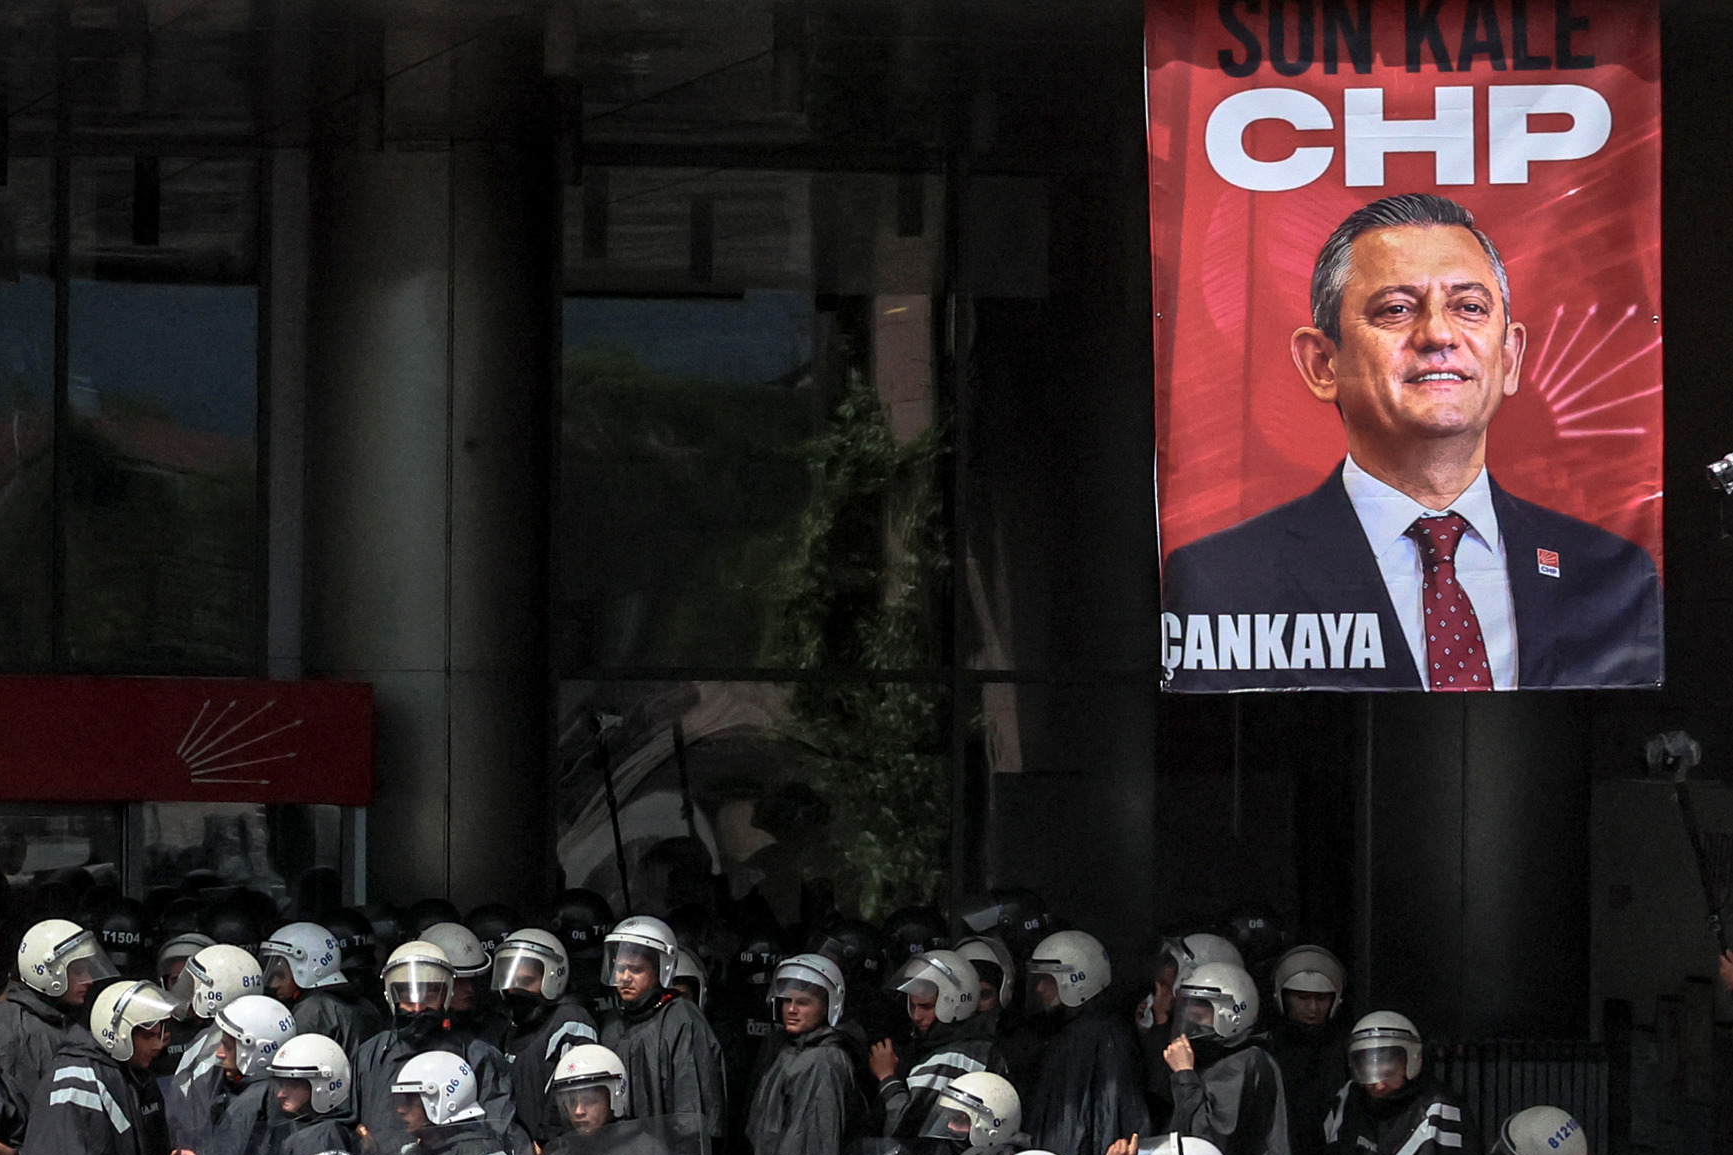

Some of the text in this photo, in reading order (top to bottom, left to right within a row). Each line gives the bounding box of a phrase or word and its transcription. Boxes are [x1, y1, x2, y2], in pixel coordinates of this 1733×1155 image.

[1217, 0, 1595, 77] SON KALE
[1205, 84, 1612, 192] CHP
[1161, 612, 1386, 682] ÇANKAYA
[320, 952, 333, 966] 06
[1070, 971, 1086, 983] 06
[208, 991, 223, 1002] 06
[960, 993, 972, 1003] 06
[1233, 1001, 1247, 1014] 06
[102, 1028, 115, 1041] 06
[264, 1042, 278, 1054] 06
[329, 1078, 342, 1091] 06
[446, 1079, 460, 1094] 06
